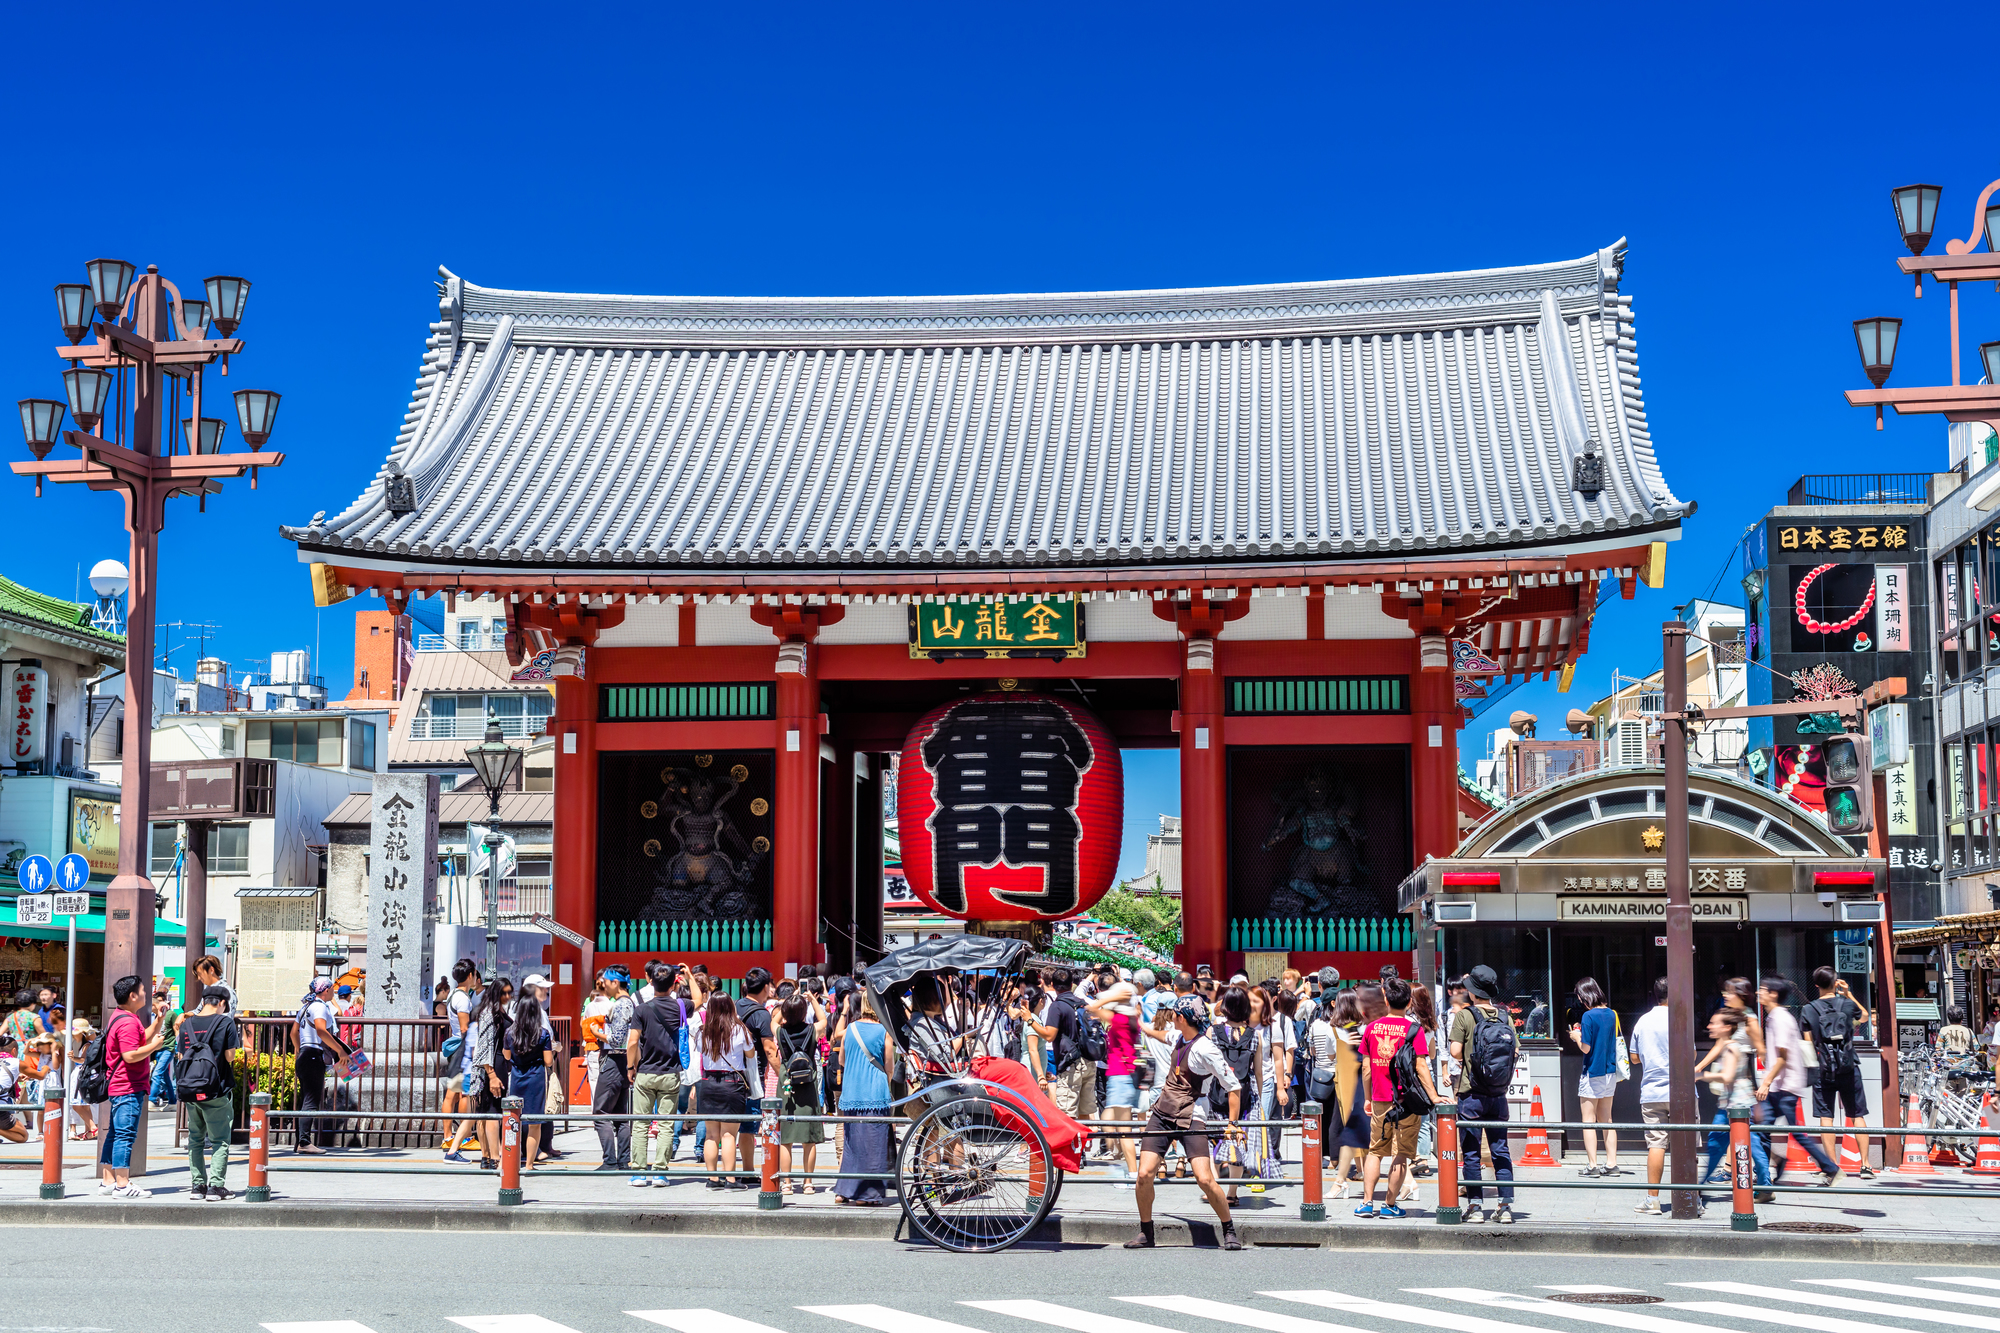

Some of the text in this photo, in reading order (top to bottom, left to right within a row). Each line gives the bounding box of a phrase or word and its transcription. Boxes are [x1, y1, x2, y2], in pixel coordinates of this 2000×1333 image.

[1780, 526, 1908, 550] 日本宝石館
[1884, 574, 1902, 642] 日本珊瑚
[931, 602, 1062, 642] 金龍山
[1891, 764, 1910, 825] 本真珠
[920, 699, 1095, 916] 雷門
[1861, 847, 1930, 869] 直送
[1563, 867, 1747, 891] 浅草警察署 雷交番
[20, 913, 48, 922] 10-22
[1572, 903, 1732, 915] KAMINARIMO OBAN
[1373, 1023, 1406, 1033] GENUINE
[1900, 1028, 1924, 1037] 天ぷら
[1442, 1150, 1456, 1160] 24K
